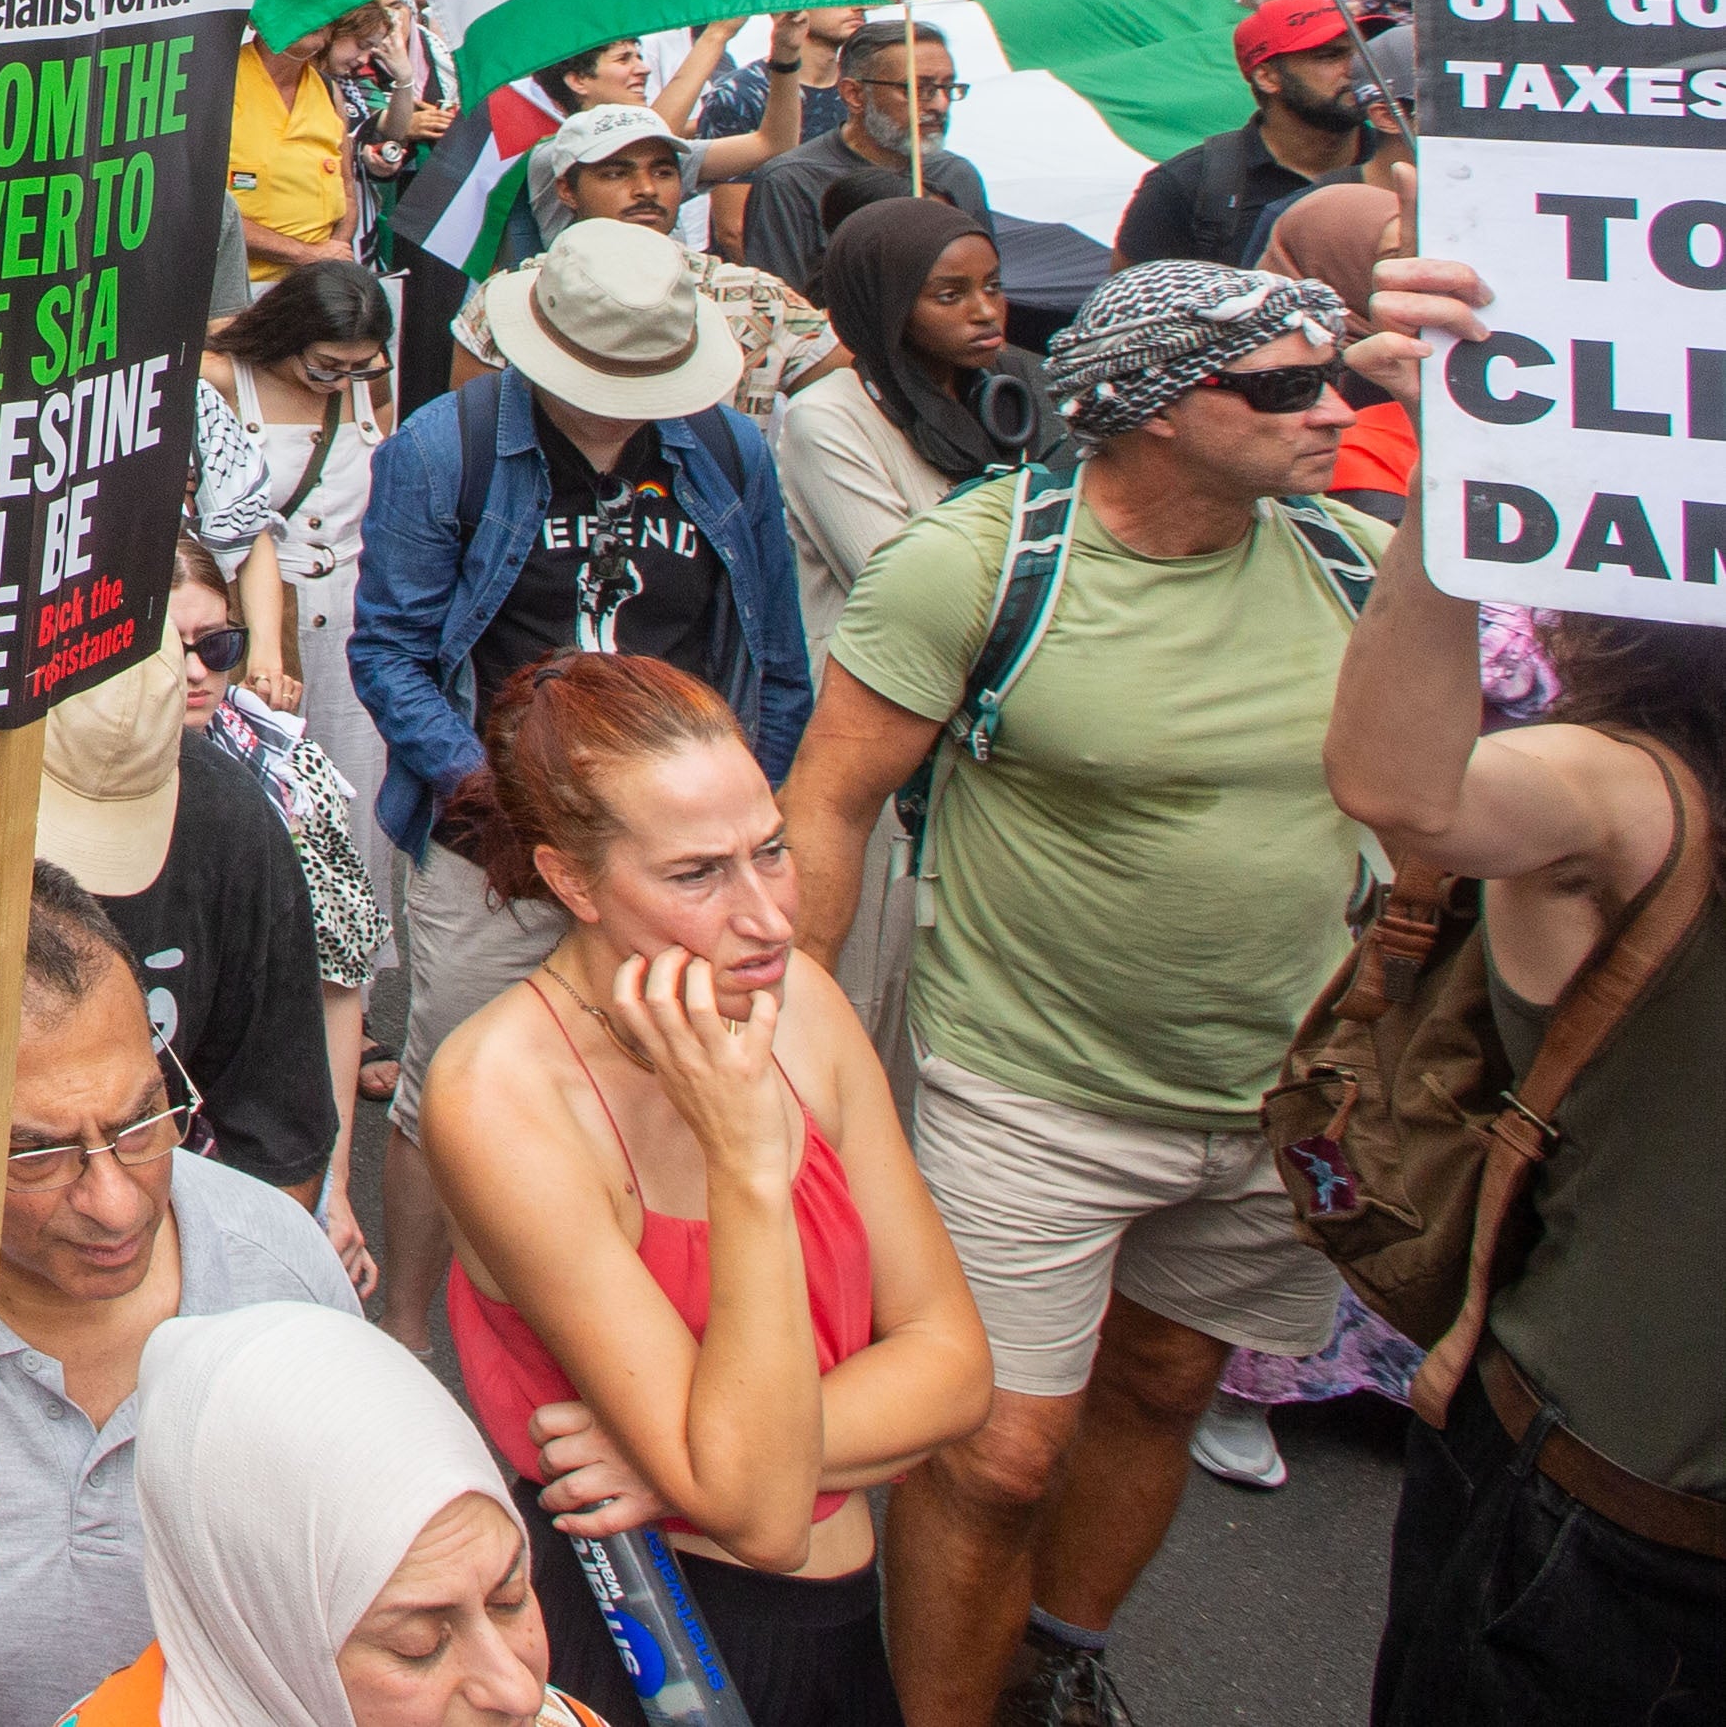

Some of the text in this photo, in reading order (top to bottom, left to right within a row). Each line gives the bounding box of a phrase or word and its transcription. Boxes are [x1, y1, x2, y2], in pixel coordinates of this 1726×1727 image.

[100, 35, 194, 147] THE
[93, 151, 155, 258] TO
[1536, 192, 1726, 291] TO
[31, 267, 118, 386] SEA
[40, 480, 99, 595] BE
[543, 515, 697, 559] EFEND
[38, 574, 123, 648] Bck the
[586, 1538, 625, 1600] water
[644, 1529, 725, 1691] smartwater
